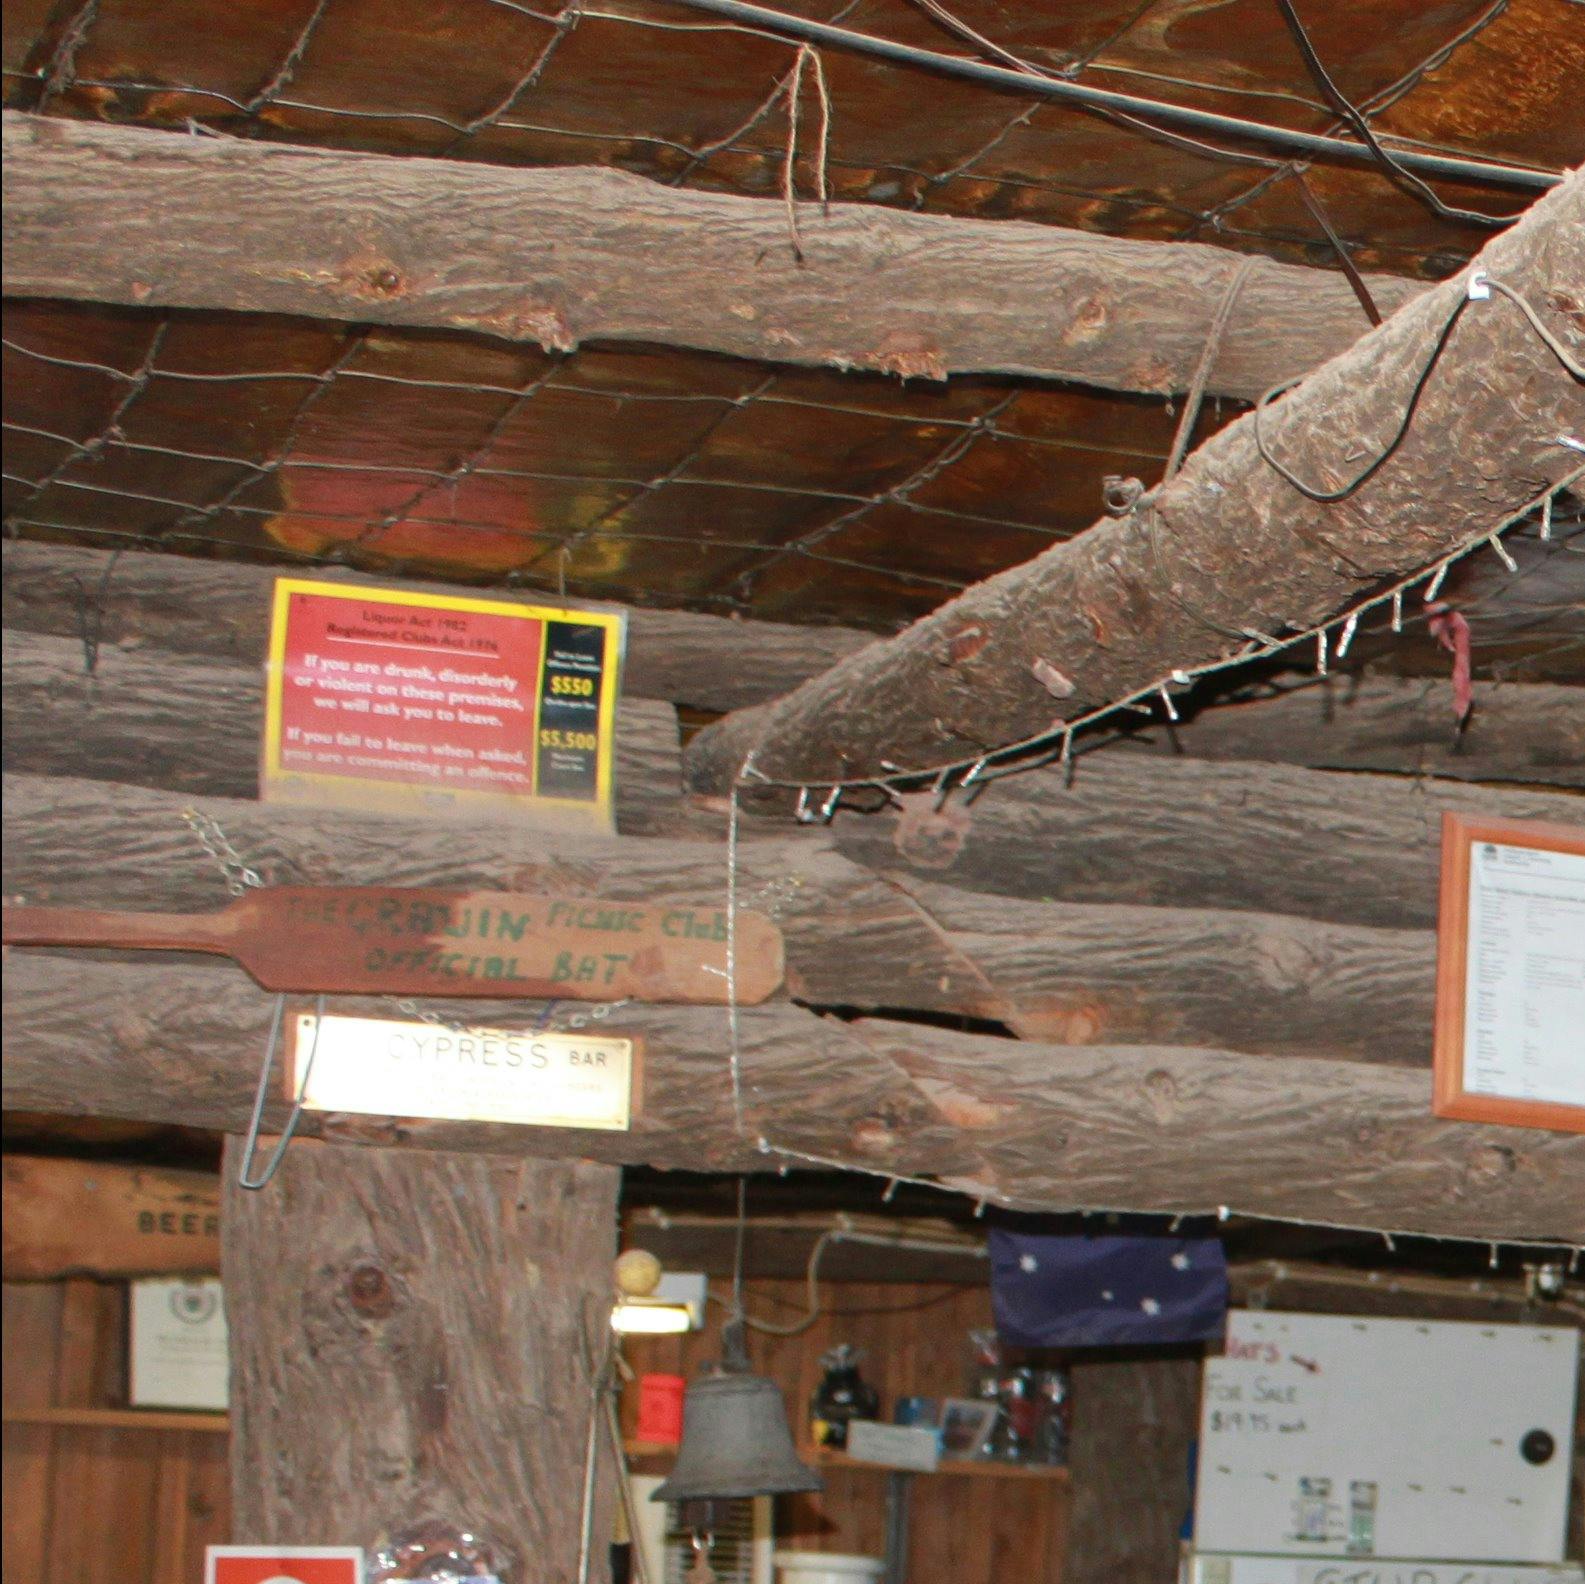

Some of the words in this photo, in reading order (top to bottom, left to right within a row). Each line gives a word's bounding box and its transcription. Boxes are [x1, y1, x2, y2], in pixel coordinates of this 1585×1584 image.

[305, 654, 317, 667] If
[320, 659, 350, 672] you
[353, 662, 381, 675] are
[385, 662, 436, 681] drunk,
[439, 669, 517, 692] disorderly
[551, 676, 593, 696] $550
[295, 675, 313, 687] or
[317, 676, 373, 694] violent
[377, 683, 397, 695] on
[402, 683, 445, 700] these
[449, 693, 524, 711] premises,
[314, 697, 337, 709] we
[342, 698, 369, 712] will
[373, 701, 400, 716] ask
[403, 707, 433, 719] you
[437, 708, 455, 721] to
[550, 953, 628, 985] BAT
[387, 1031, 550, 1070] CYPRESS
[568, 1049, 609, 1068] BAR
[137, 1210, 220, 1235] BEER
